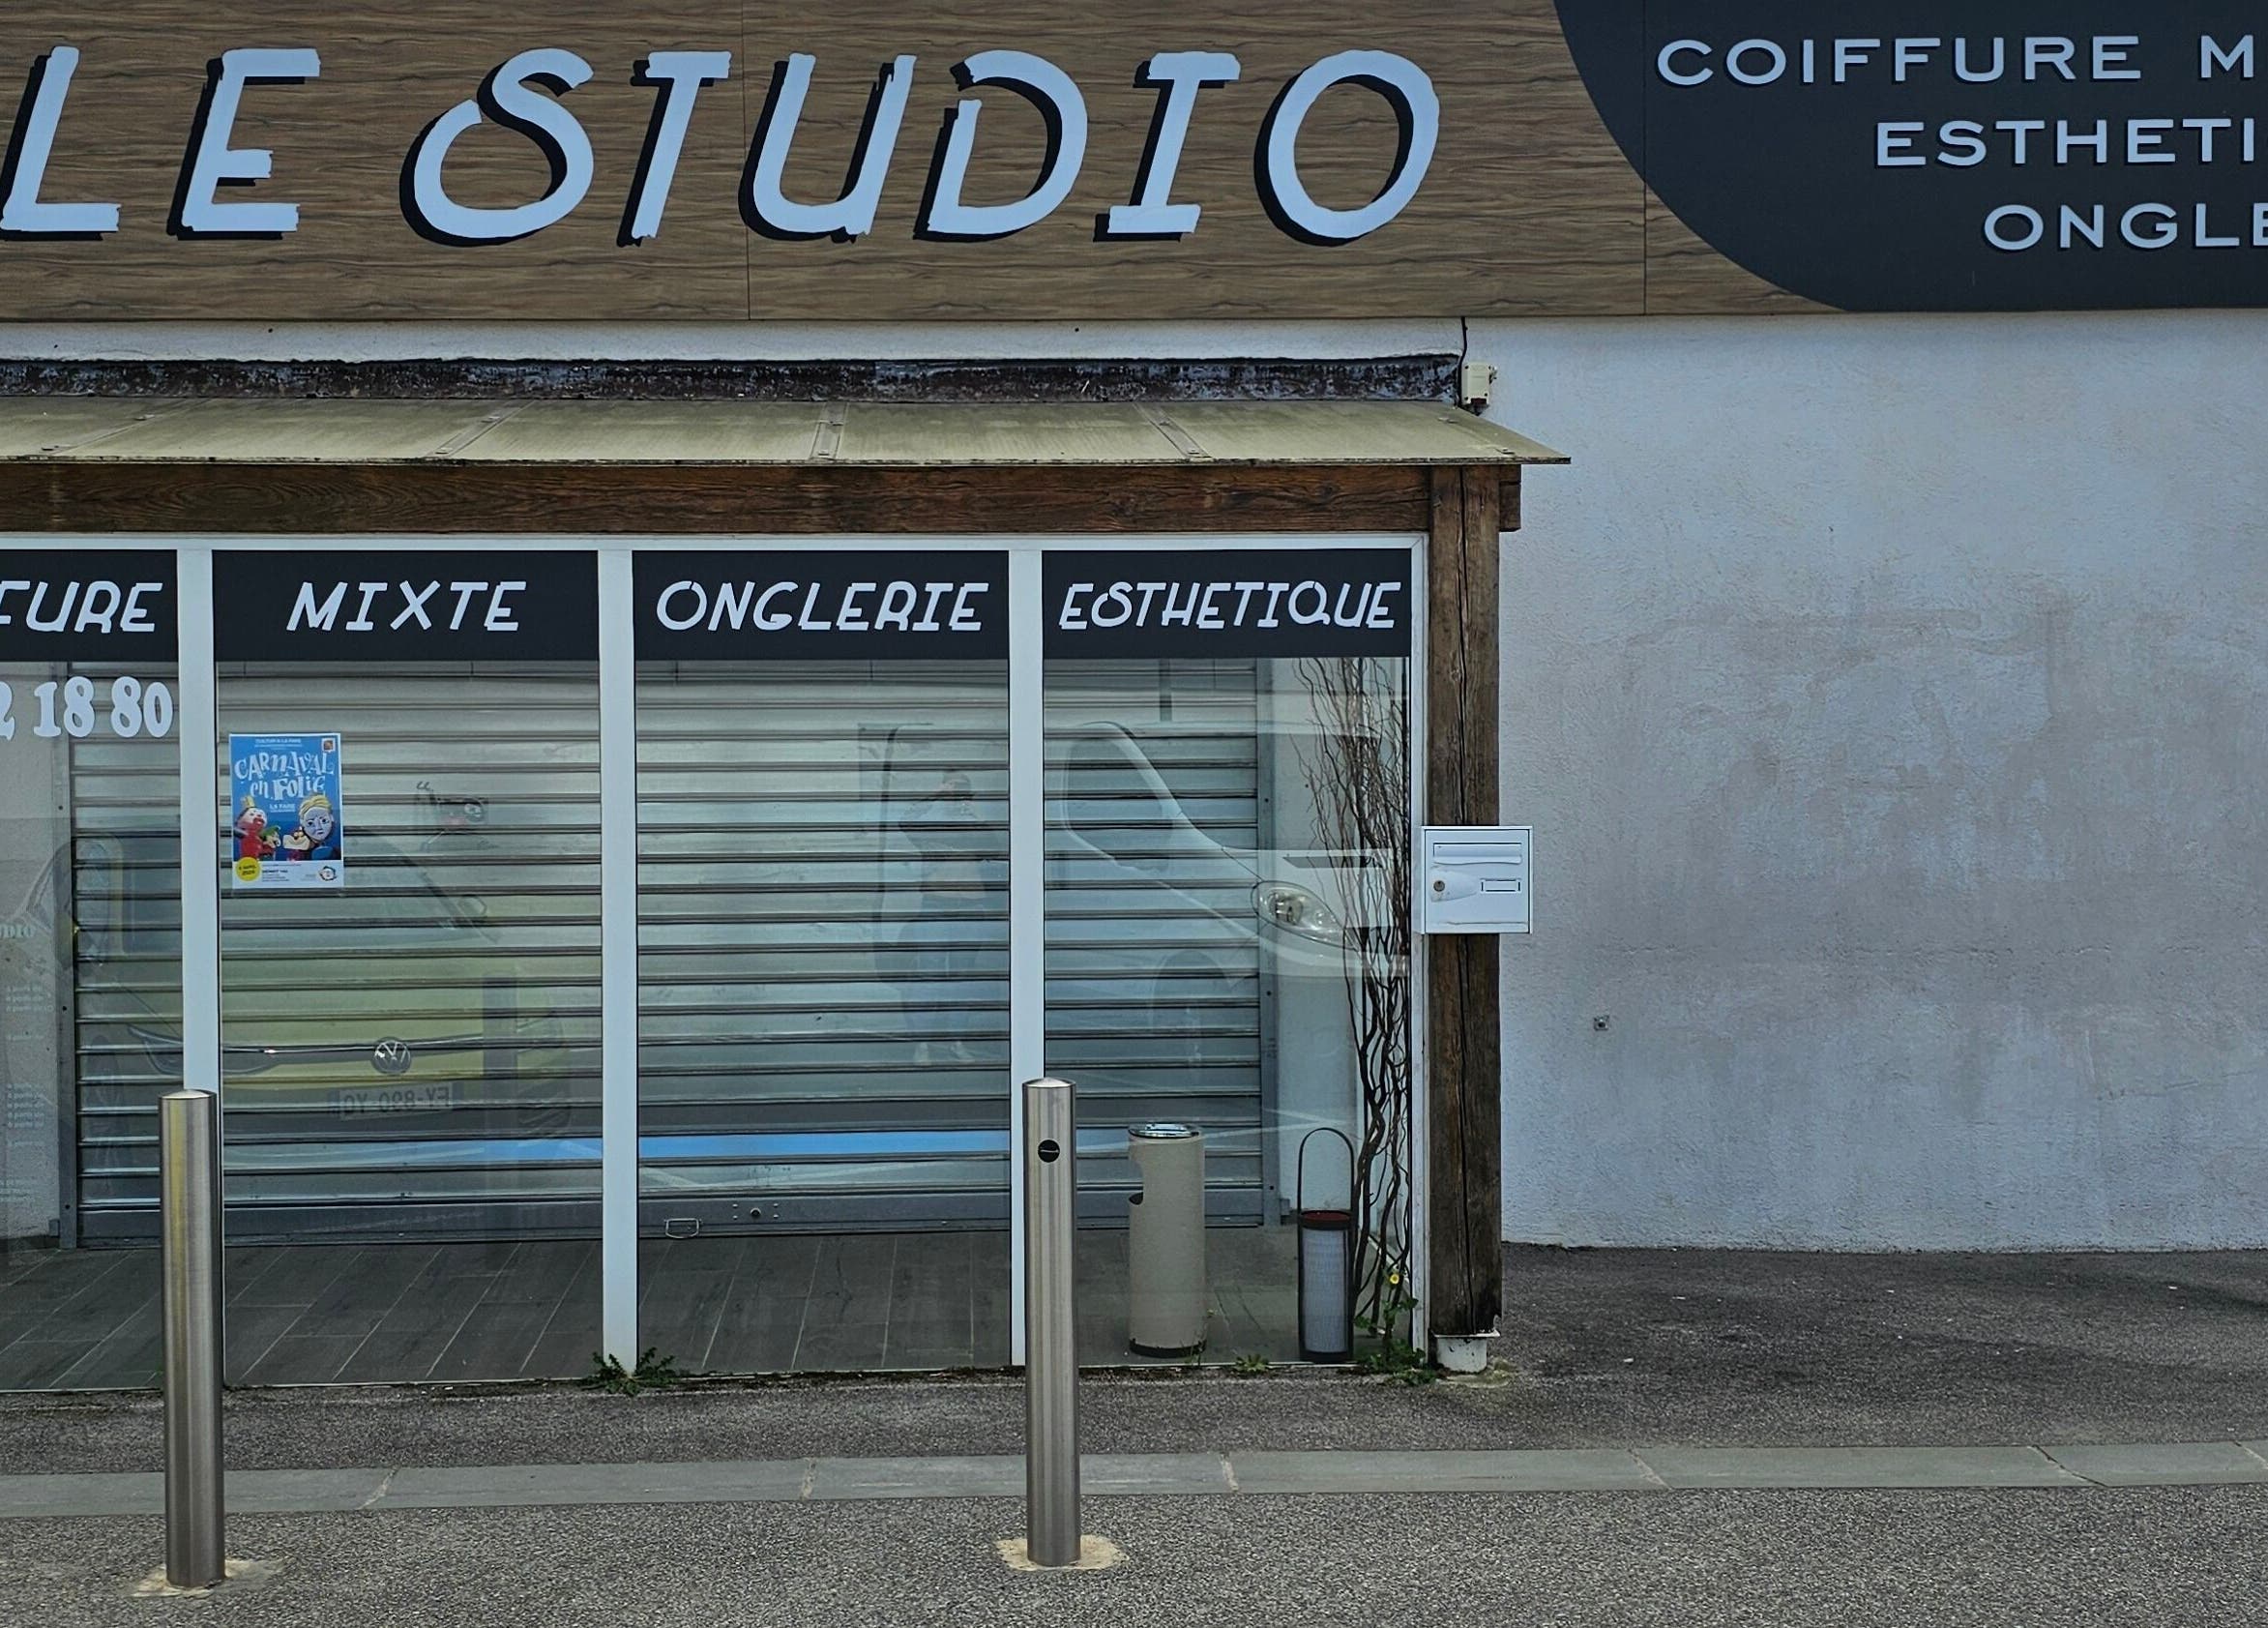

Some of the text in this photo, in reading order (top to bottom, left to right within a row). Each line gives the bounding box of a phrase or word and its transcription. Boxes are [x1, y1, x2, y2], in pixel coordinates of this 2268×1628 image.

[1657, 35, 2141, 86] COIFFURE
[0, 46, 1440, 240] LE STUDIO
[1877, 117, 2254, 166] ESTHETI
[286, 580, 527, 632] MIXTE
[656, 580, 989, 632] ONGLERIE
[1058, 580, 1401, 630] ESTHETIQUE
[33, 676, 95, 738] 18
[111, 676, 173, 738] 80
